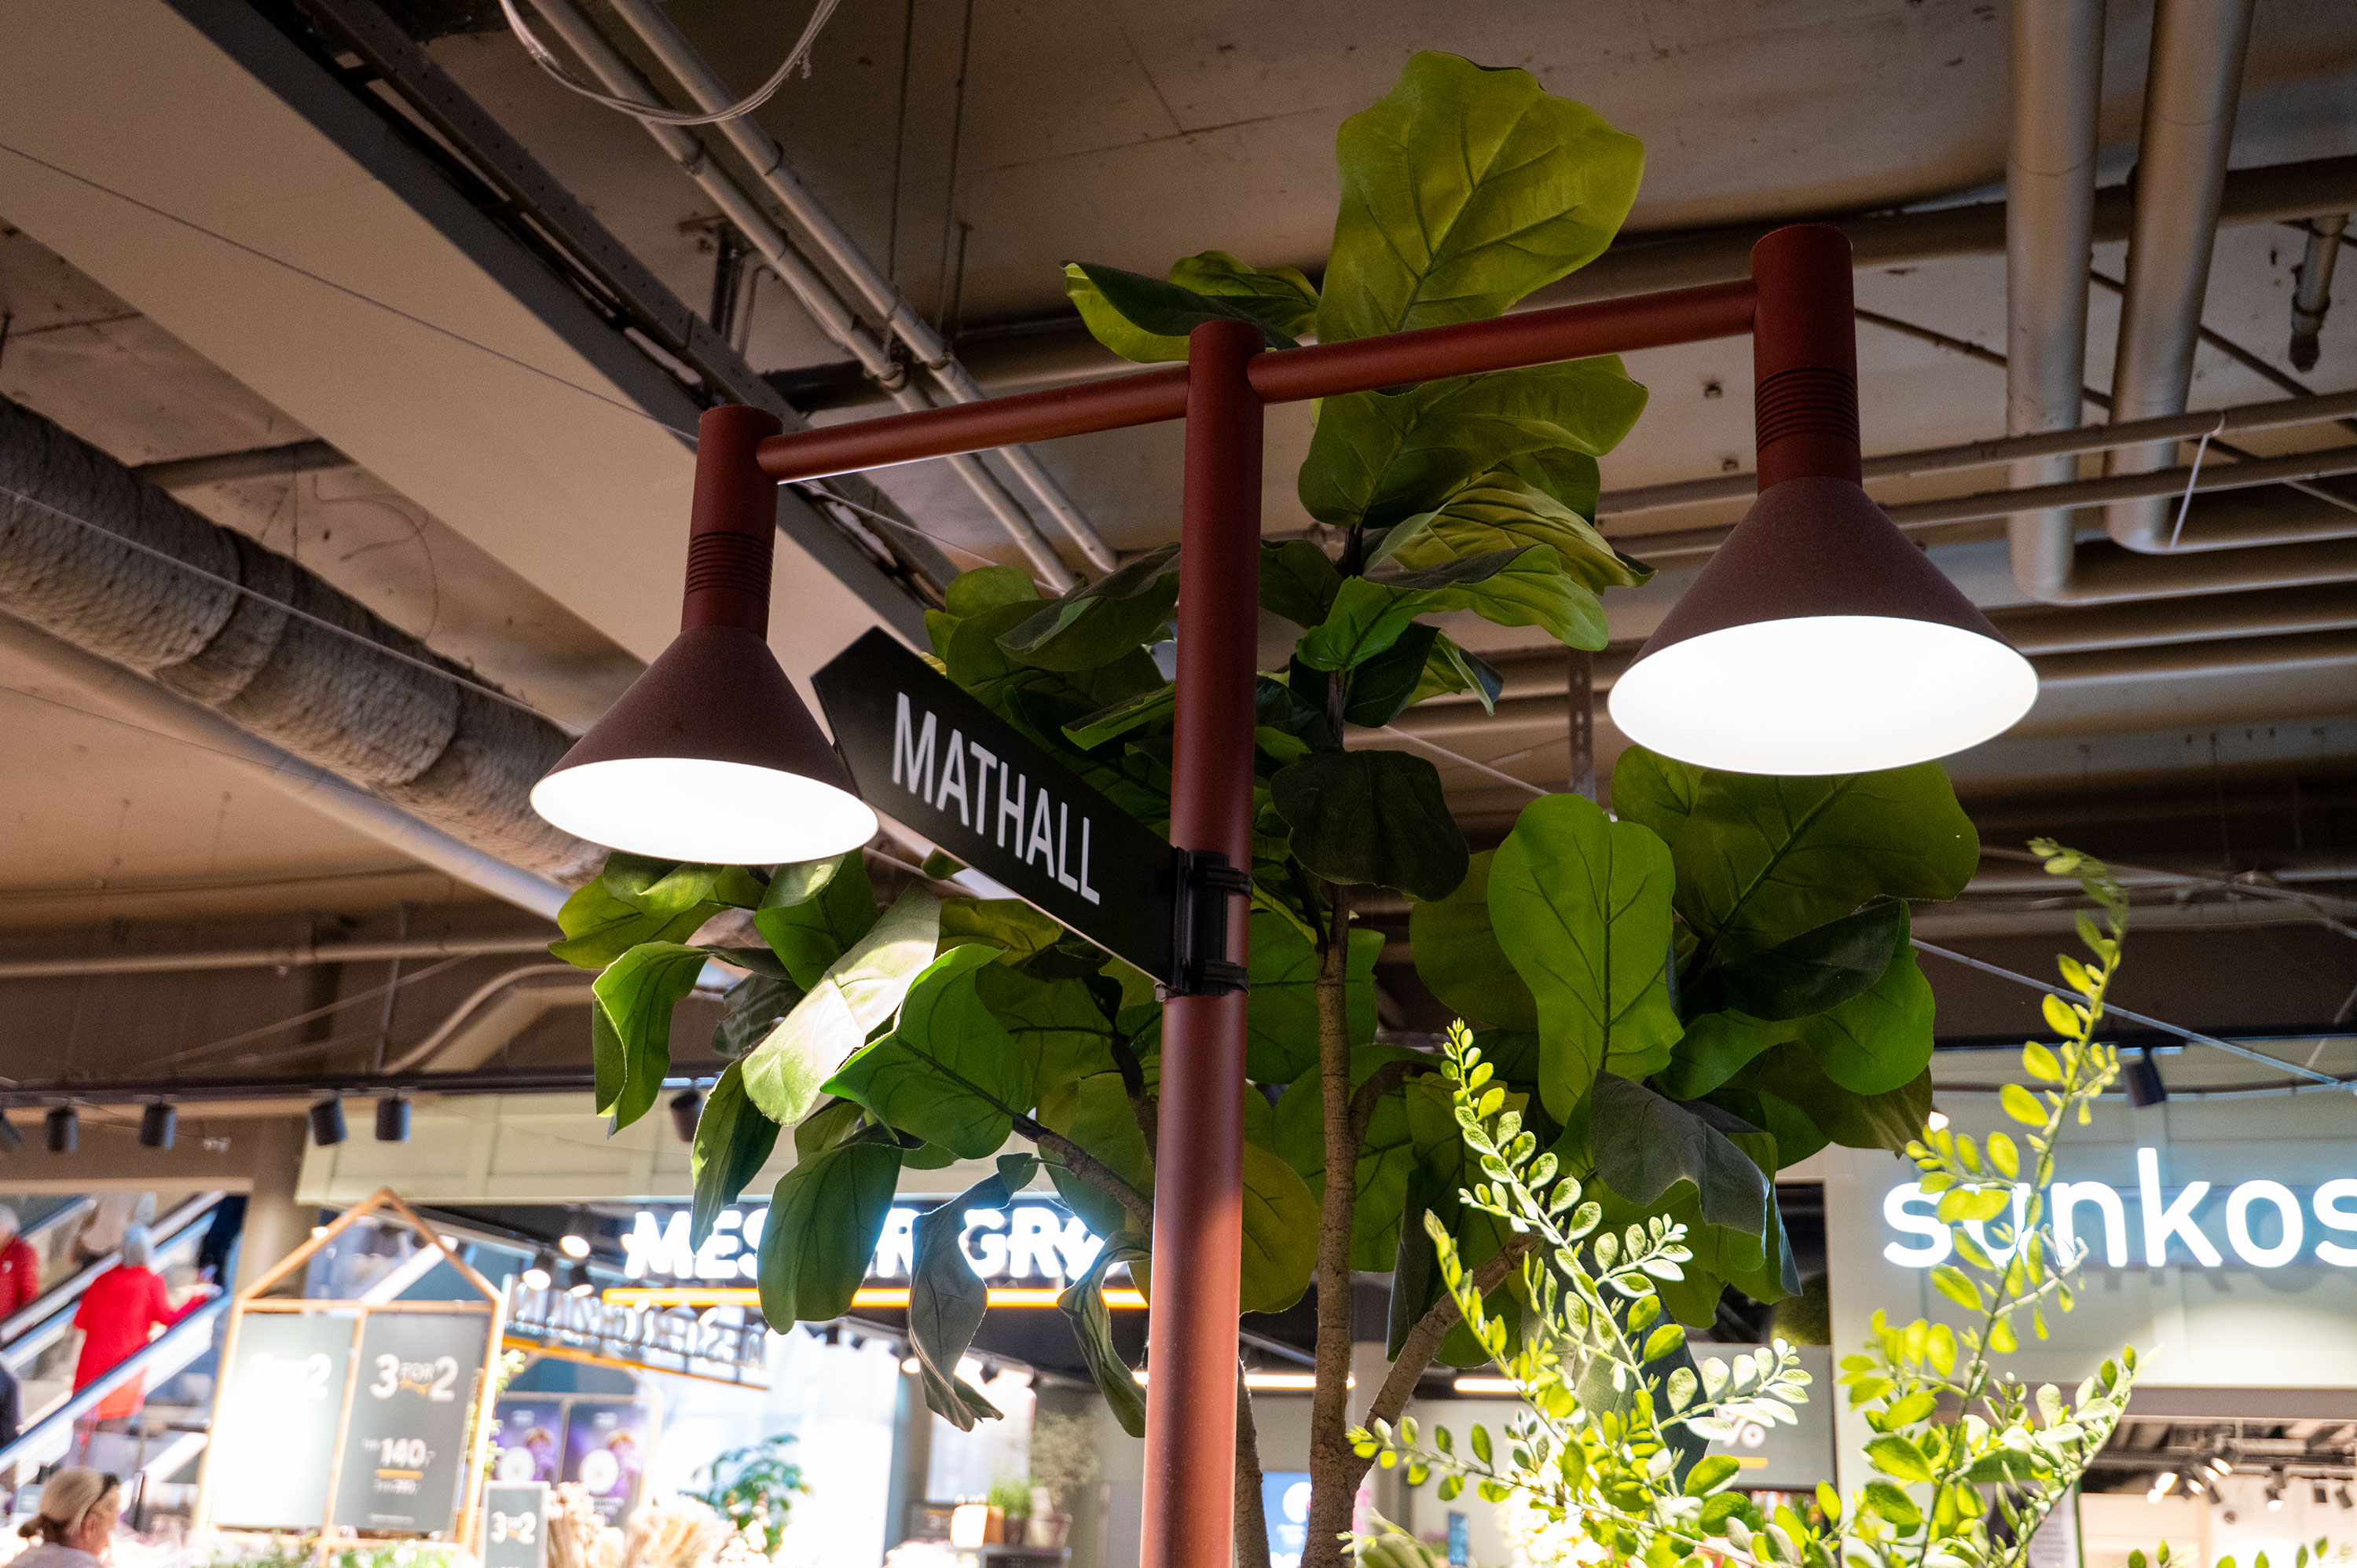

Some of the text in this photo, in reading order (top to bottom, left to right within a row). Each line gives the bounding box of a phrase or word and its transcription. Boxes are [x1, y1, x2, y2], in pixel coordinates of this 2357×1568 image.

[893, 691, 1100, 905] MATHALL
[369, 1354, 400, 1399] 3
[428, 1355, 459, 1401] 2
